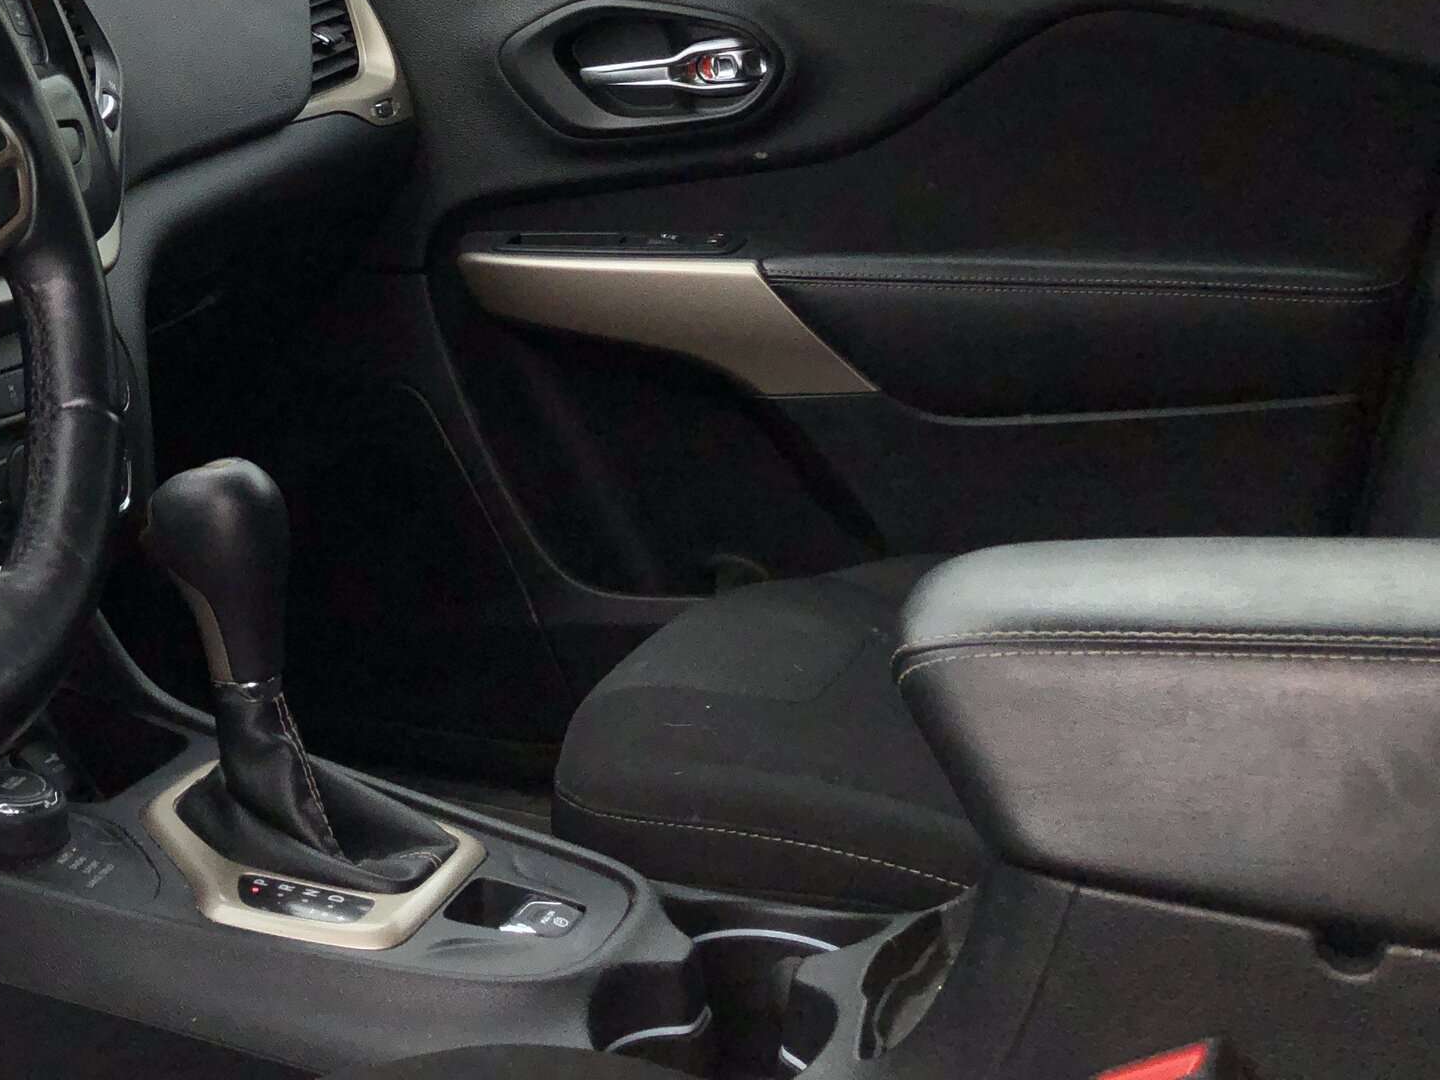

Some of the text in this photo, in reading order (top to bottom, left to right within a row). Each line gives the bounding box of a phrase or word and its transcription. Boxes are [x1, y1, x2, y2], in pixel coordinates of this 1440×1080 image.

[253, 878, 345, 903] P R N D
